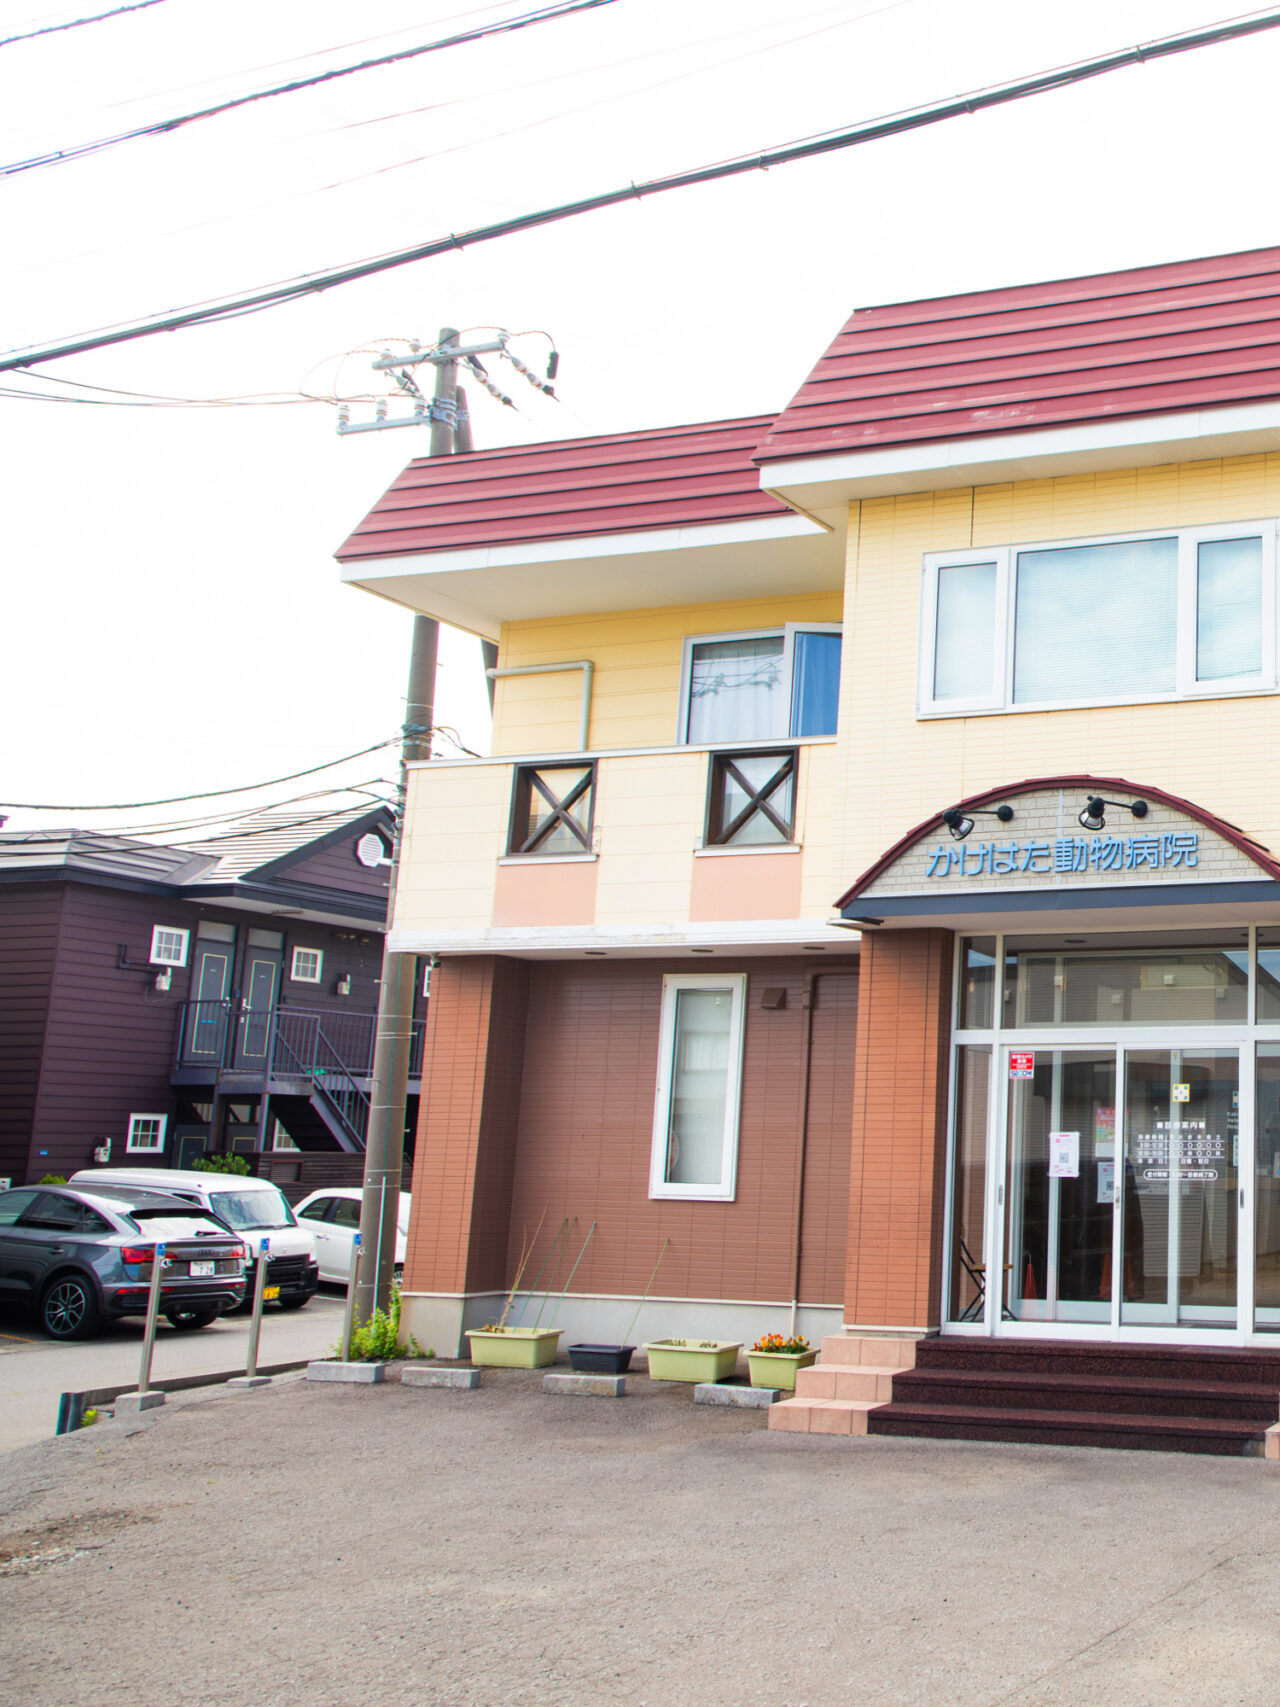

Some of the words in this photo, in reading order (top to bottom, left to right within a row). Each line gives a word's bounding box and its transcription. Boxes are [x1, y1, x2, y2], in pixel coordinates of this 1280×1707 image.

[926, 832, 1199, 878] かけはた動物病院
